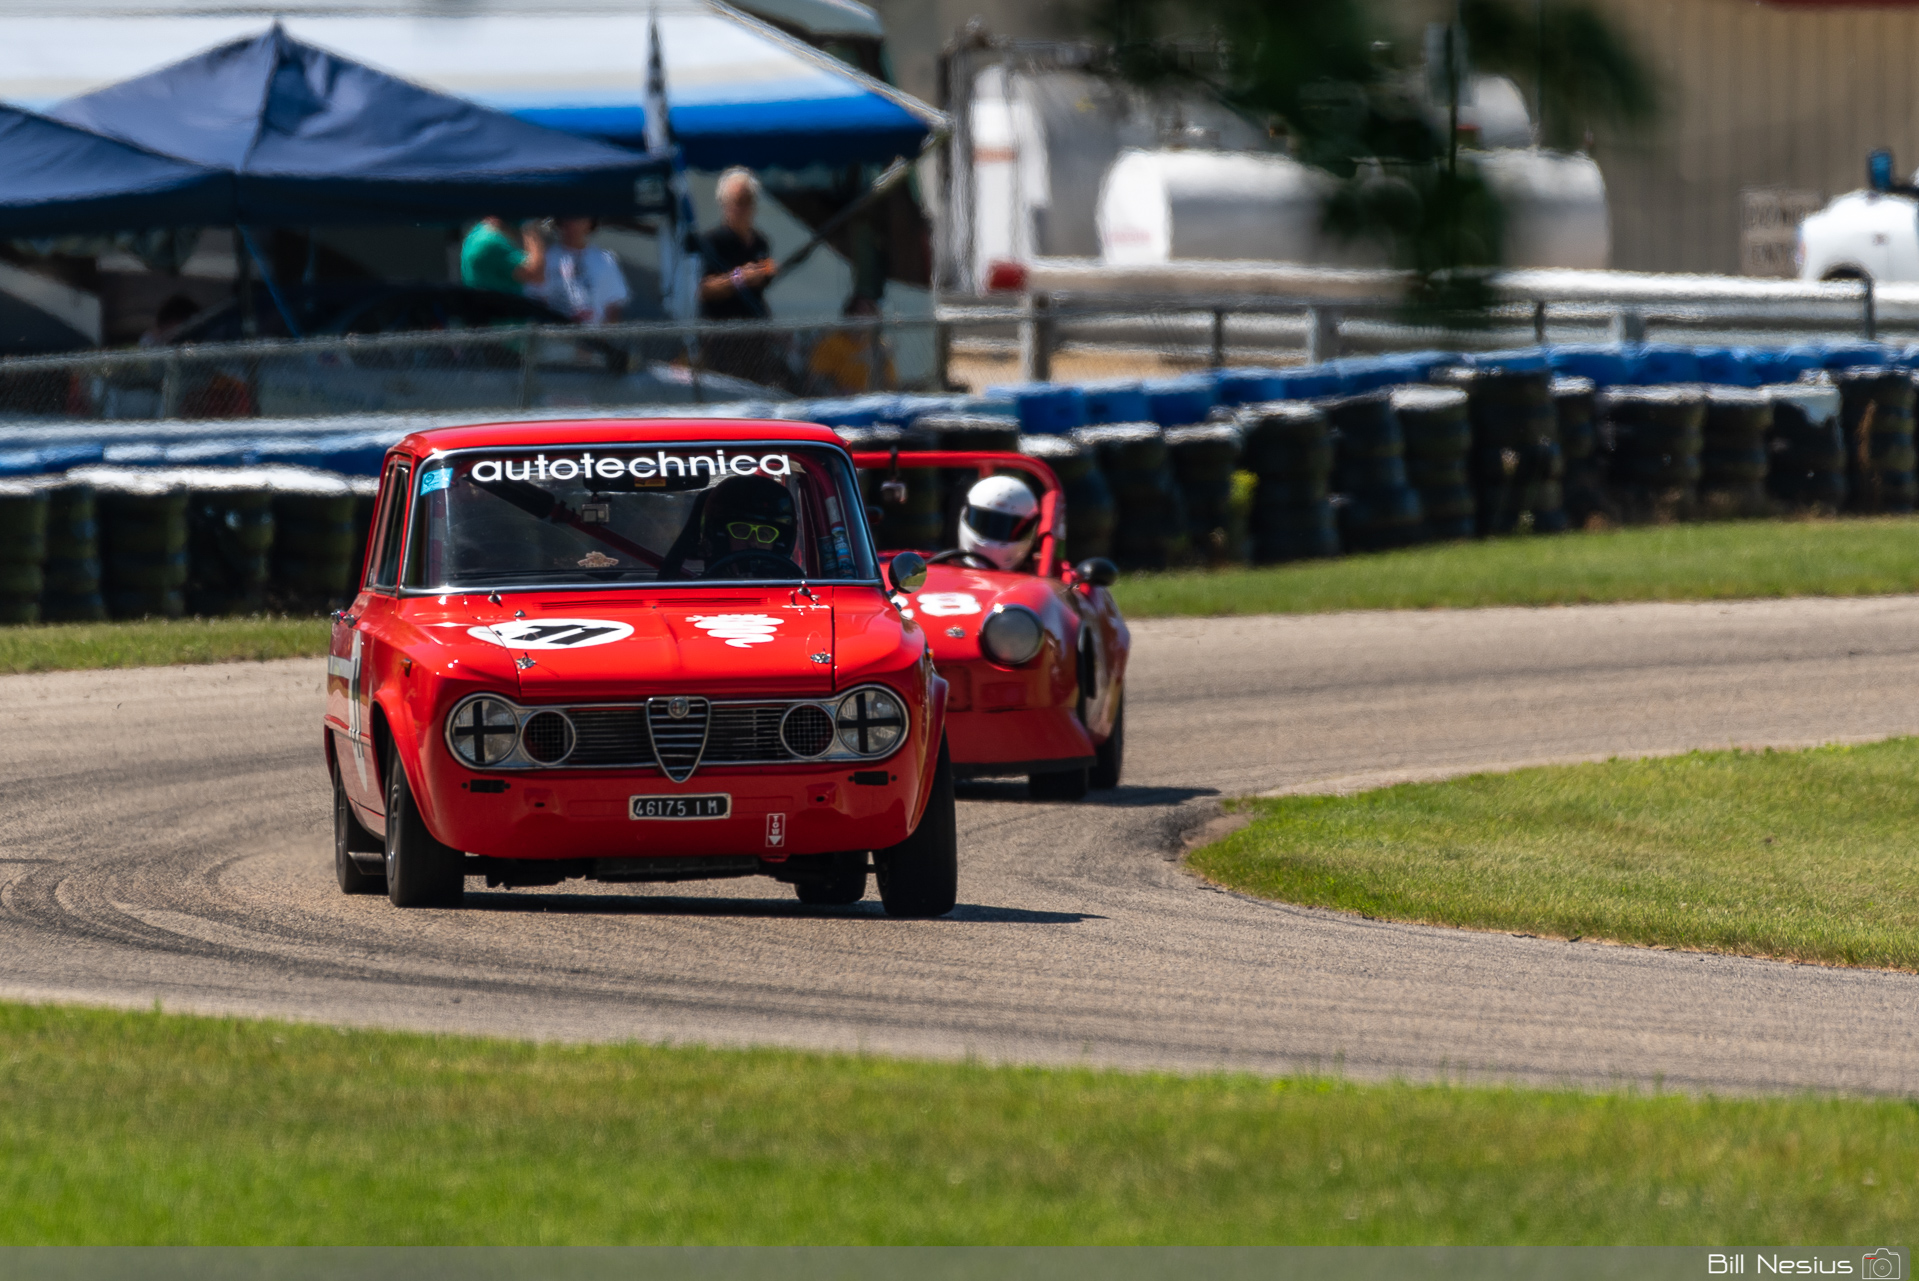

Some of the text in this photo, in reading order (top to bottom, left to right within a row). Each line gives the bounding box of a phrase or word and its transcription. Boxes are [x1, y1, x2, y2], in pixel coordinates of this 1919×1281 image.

[471, 450, 791, 482] autotechnica
[635, 801, 687, 816] 46175
[771, 815, 780, 835] TOW
